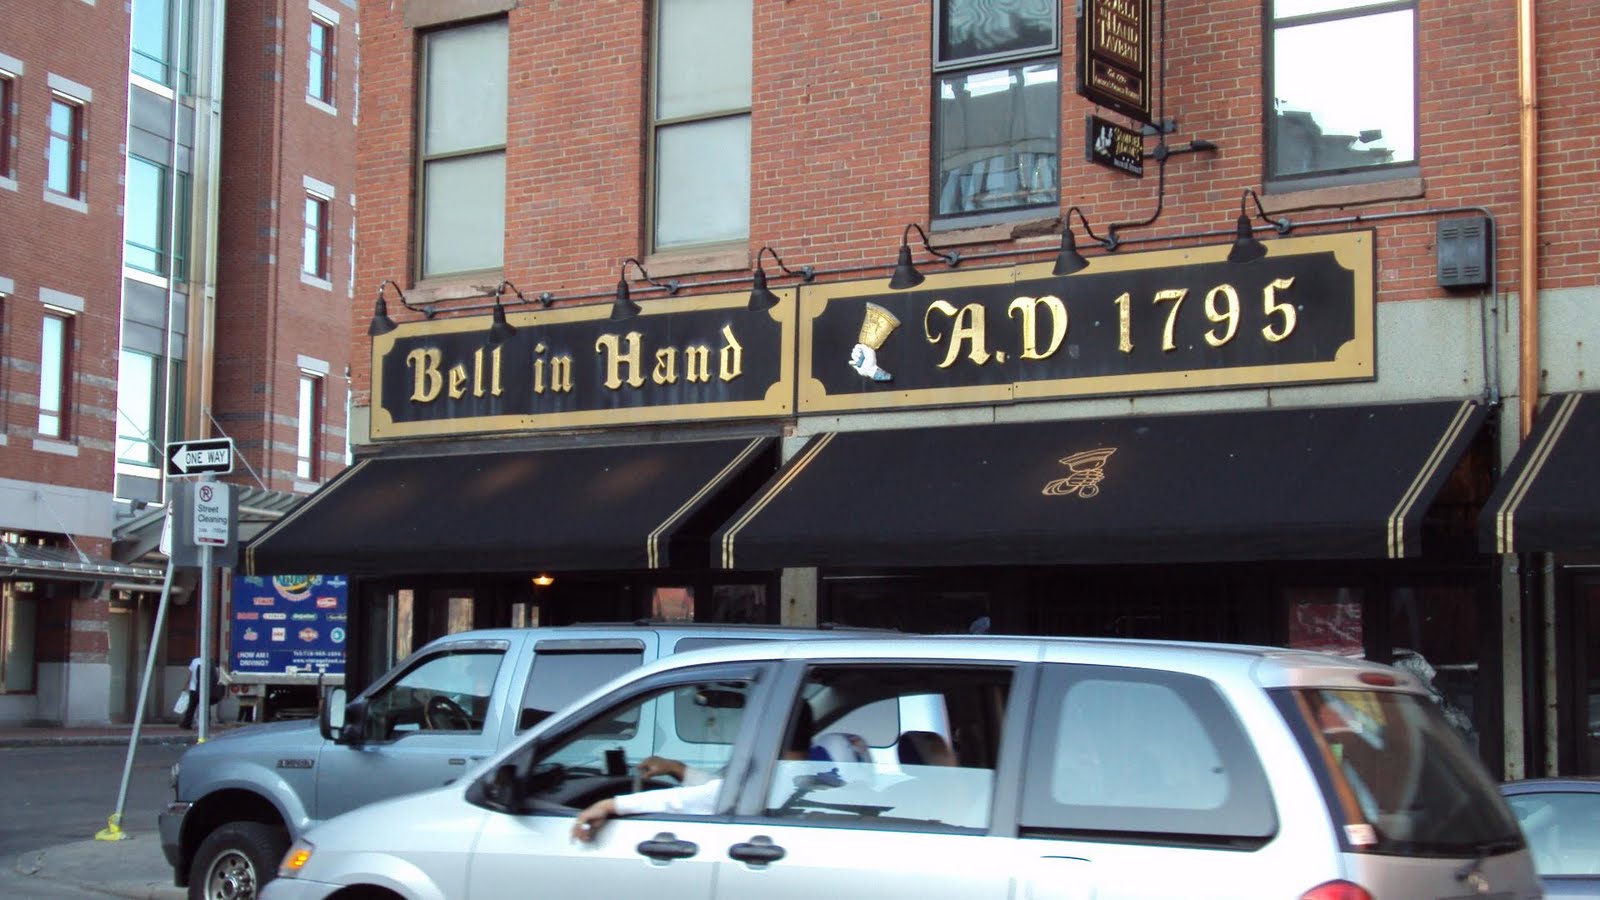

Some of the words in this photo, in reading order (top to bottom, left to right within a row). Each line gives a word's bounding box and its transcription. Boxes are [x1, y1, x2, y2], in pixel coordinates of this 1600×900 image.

[1114, 276, 1297, 355] 1795
[406, 345, 504, 403] Bell
[533, 342, 575, 394] in
[595, 324, 744, 390] Hand
[185, 451, 203, 465] ONE
[207, 450, 225, 463] WAY
[197, 503, 219, 514] Street
[197, 514, 228, 526] Cleaning
[240, 651, 255, 659] HOW
